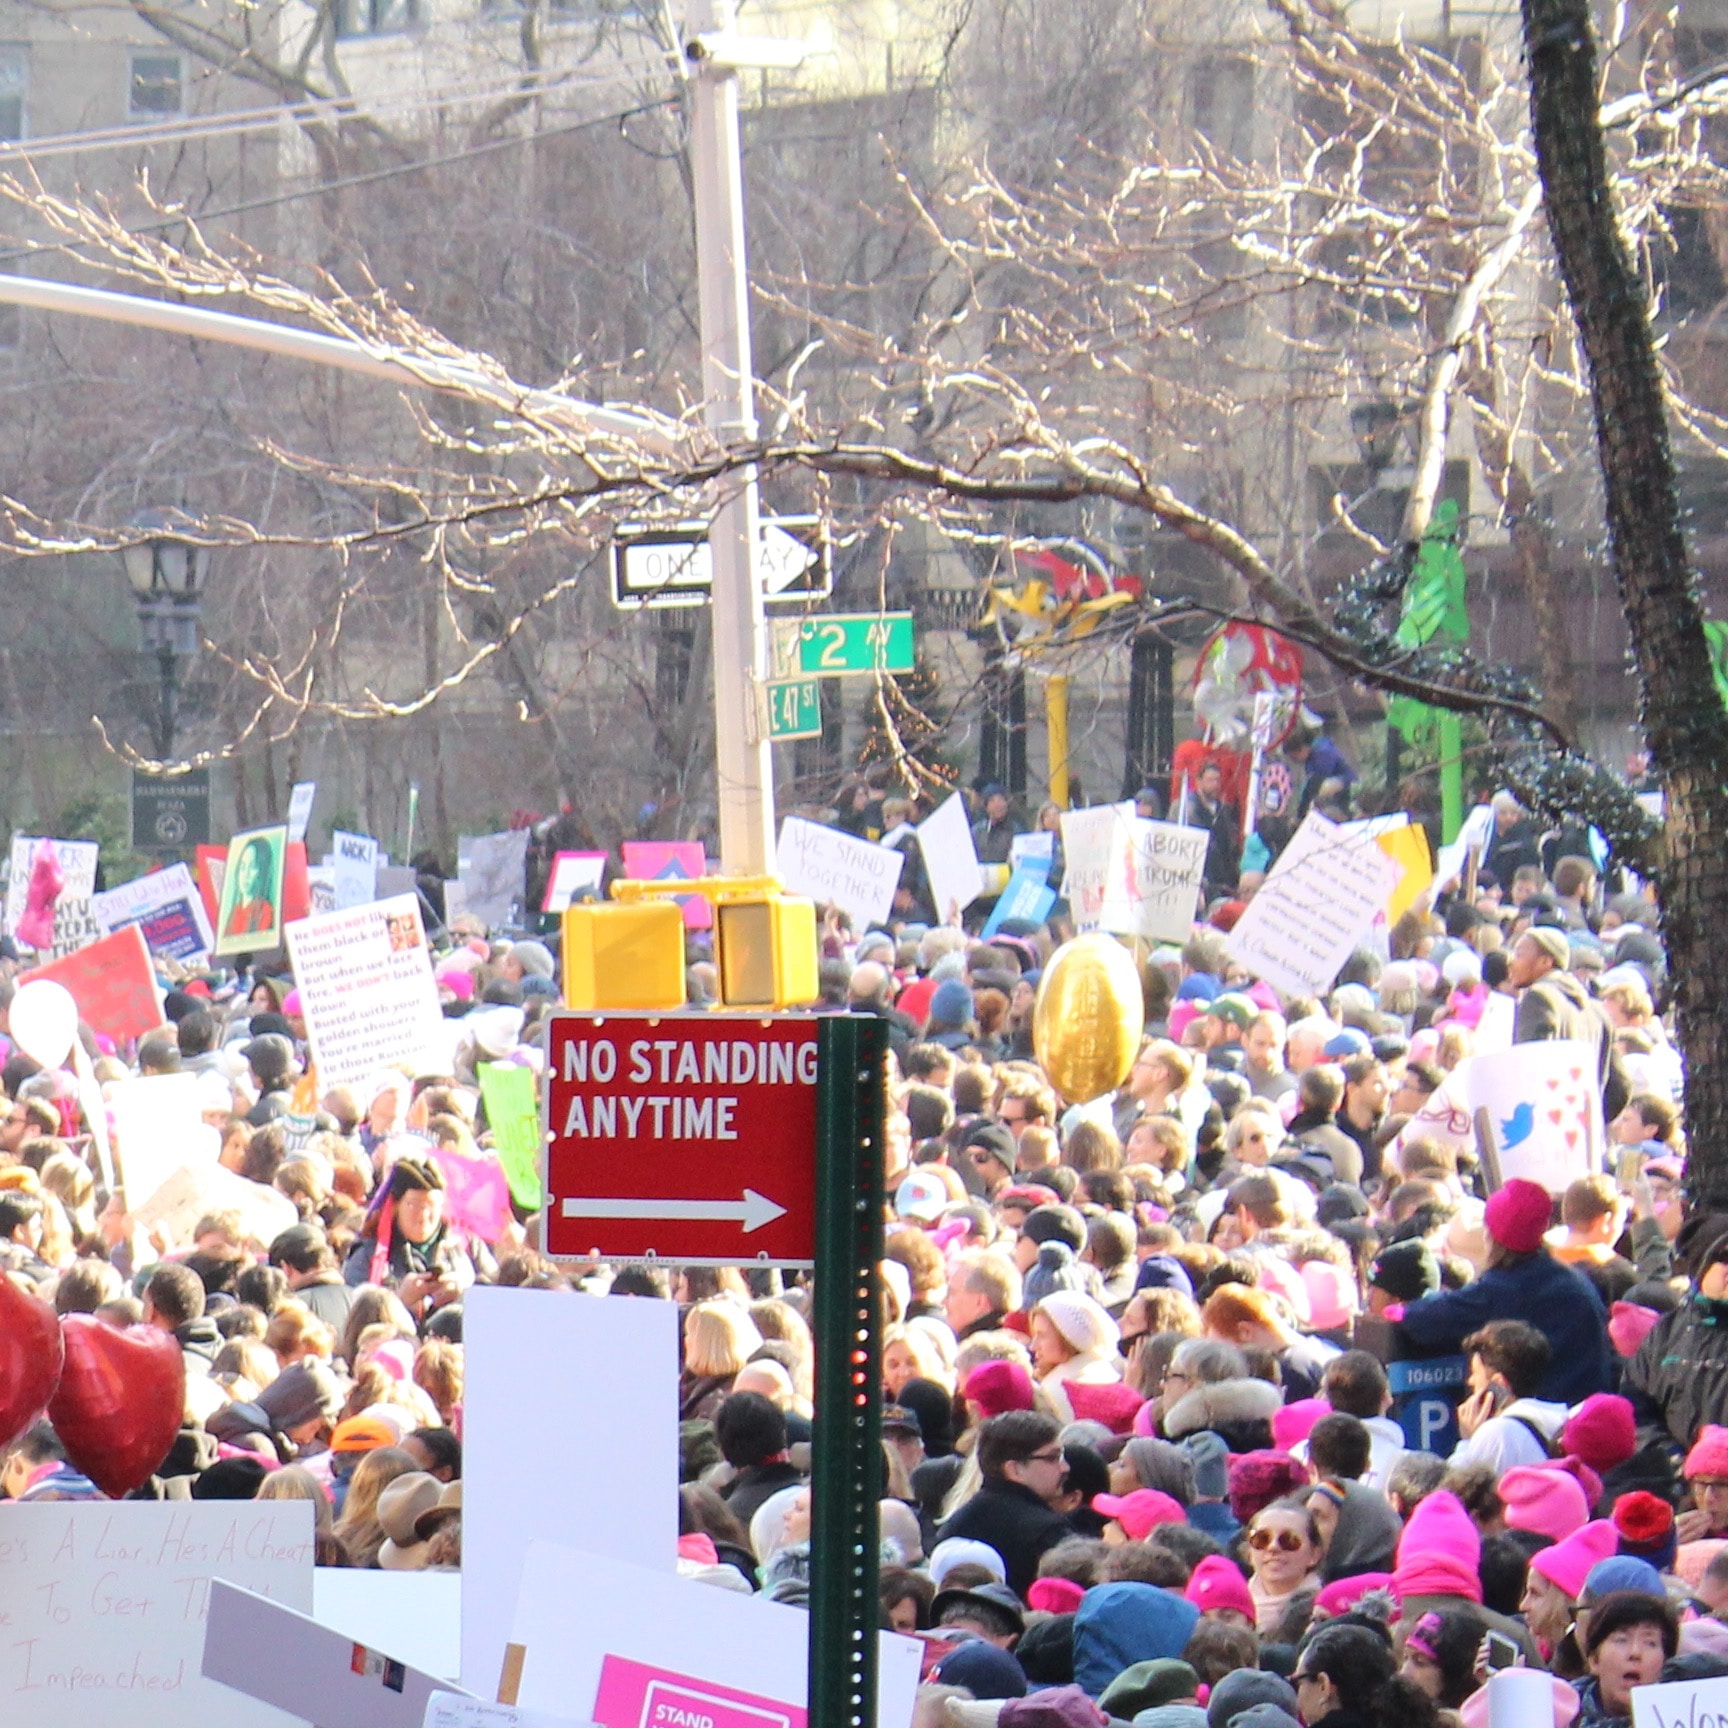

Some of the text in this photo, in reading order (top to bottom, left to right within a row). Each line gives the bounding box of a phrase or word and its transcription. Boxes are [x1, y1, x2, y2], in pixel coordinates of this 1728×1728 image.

[646, 546, 794, 579] ONE AY
[819, 624, 848, 667] 2
[769, 685, 815, 731] E 47 ST
[794, 821, 886, 877] WE STAND
[799, 863, 882, 903] TOGETHER
[294, 931, 310, 942] He
[311, 921, 343, 938] DOES
[344, 915, 367, 930] NOT
[297, 928, 386, 957] them black or
[300, 955, 344, 972] brown
[329, 965, 364, 981] when
[366, 961, 384, 972] we
[386, 952, 414, 967] face
[334, 983, 354, 994] WE
[392, 966, 425, 981] back
[311, 1000, 348, 1016] down
[313, 998, 422, 1031] Busted with your
[317, 1027, 361, 1048] golden
[564, 1040, 818, 1084] NO STANDING
[564, 1096, 738, 1140] ANYTIME
[1419, 1399, 1450, 1451] P
[52, 1519, 77, 1564] A
[159, 1511, 212, 1567] He's
[215, 1525, 241, 1564] A
[243, 1511, 315, 1564] Cheat
[35, 1580, 72, 1627] To
[90, 1576, 157, 1622] Get
[11, 1636, 187, 1696] Impeached
